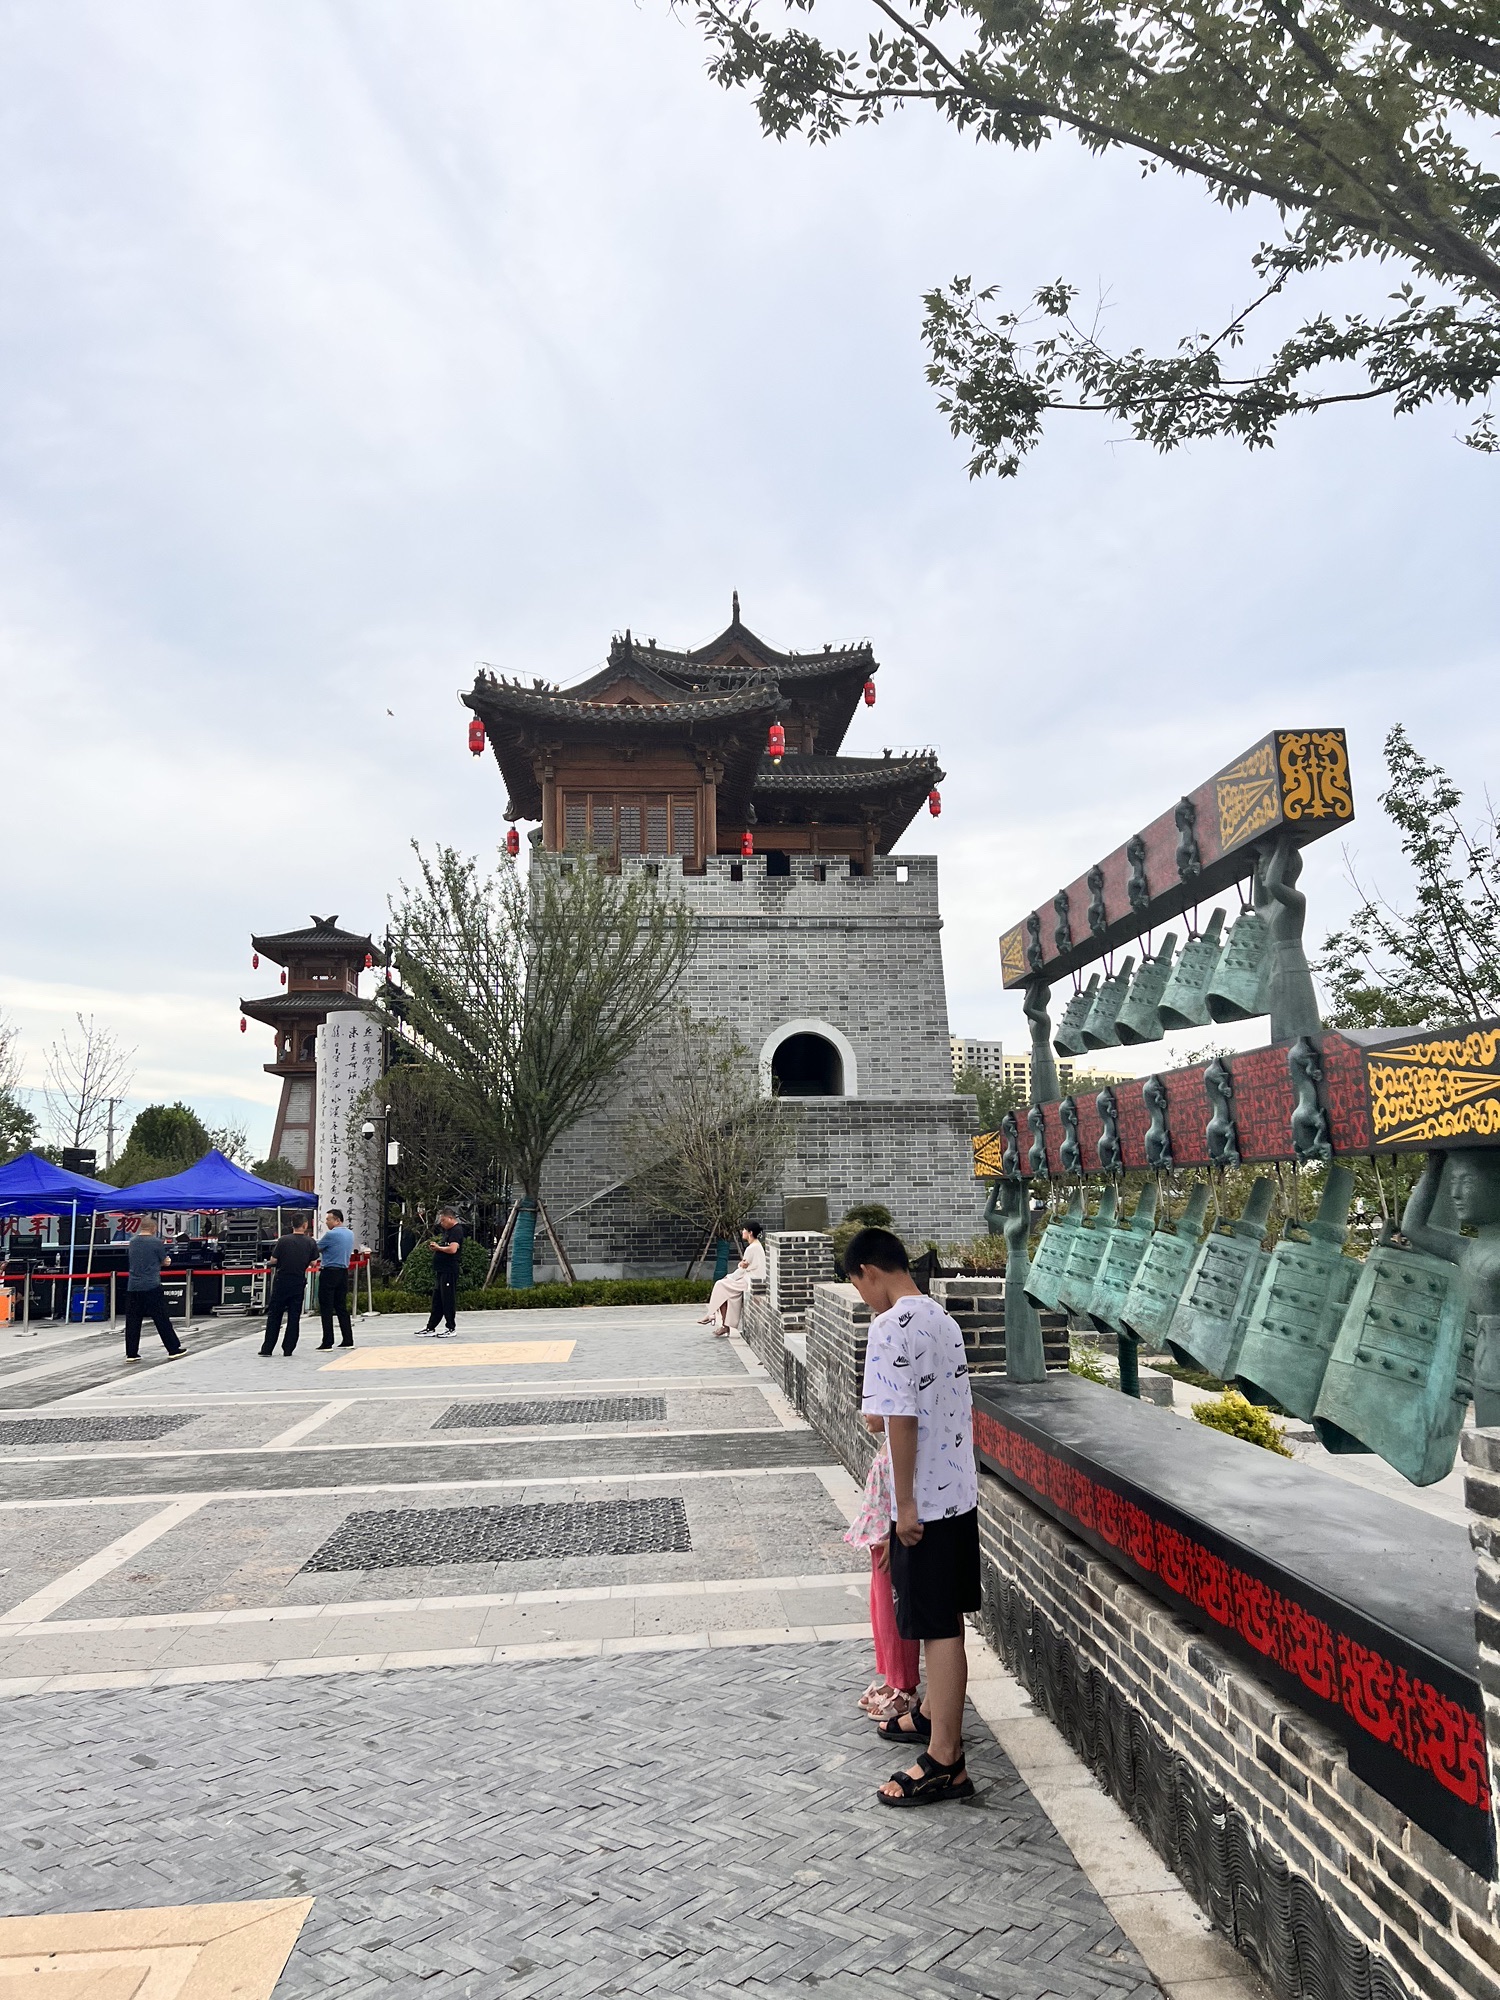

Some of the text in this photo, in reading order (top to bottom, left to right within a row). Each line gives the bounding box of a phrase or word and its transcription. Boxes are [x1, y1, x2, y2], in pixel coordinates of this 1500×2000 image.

[898, 1311, 911, 1323] NIKE
[921, 1372, 934, 1383] NIKE
[945, 1504, 958, 1515] NIKE
